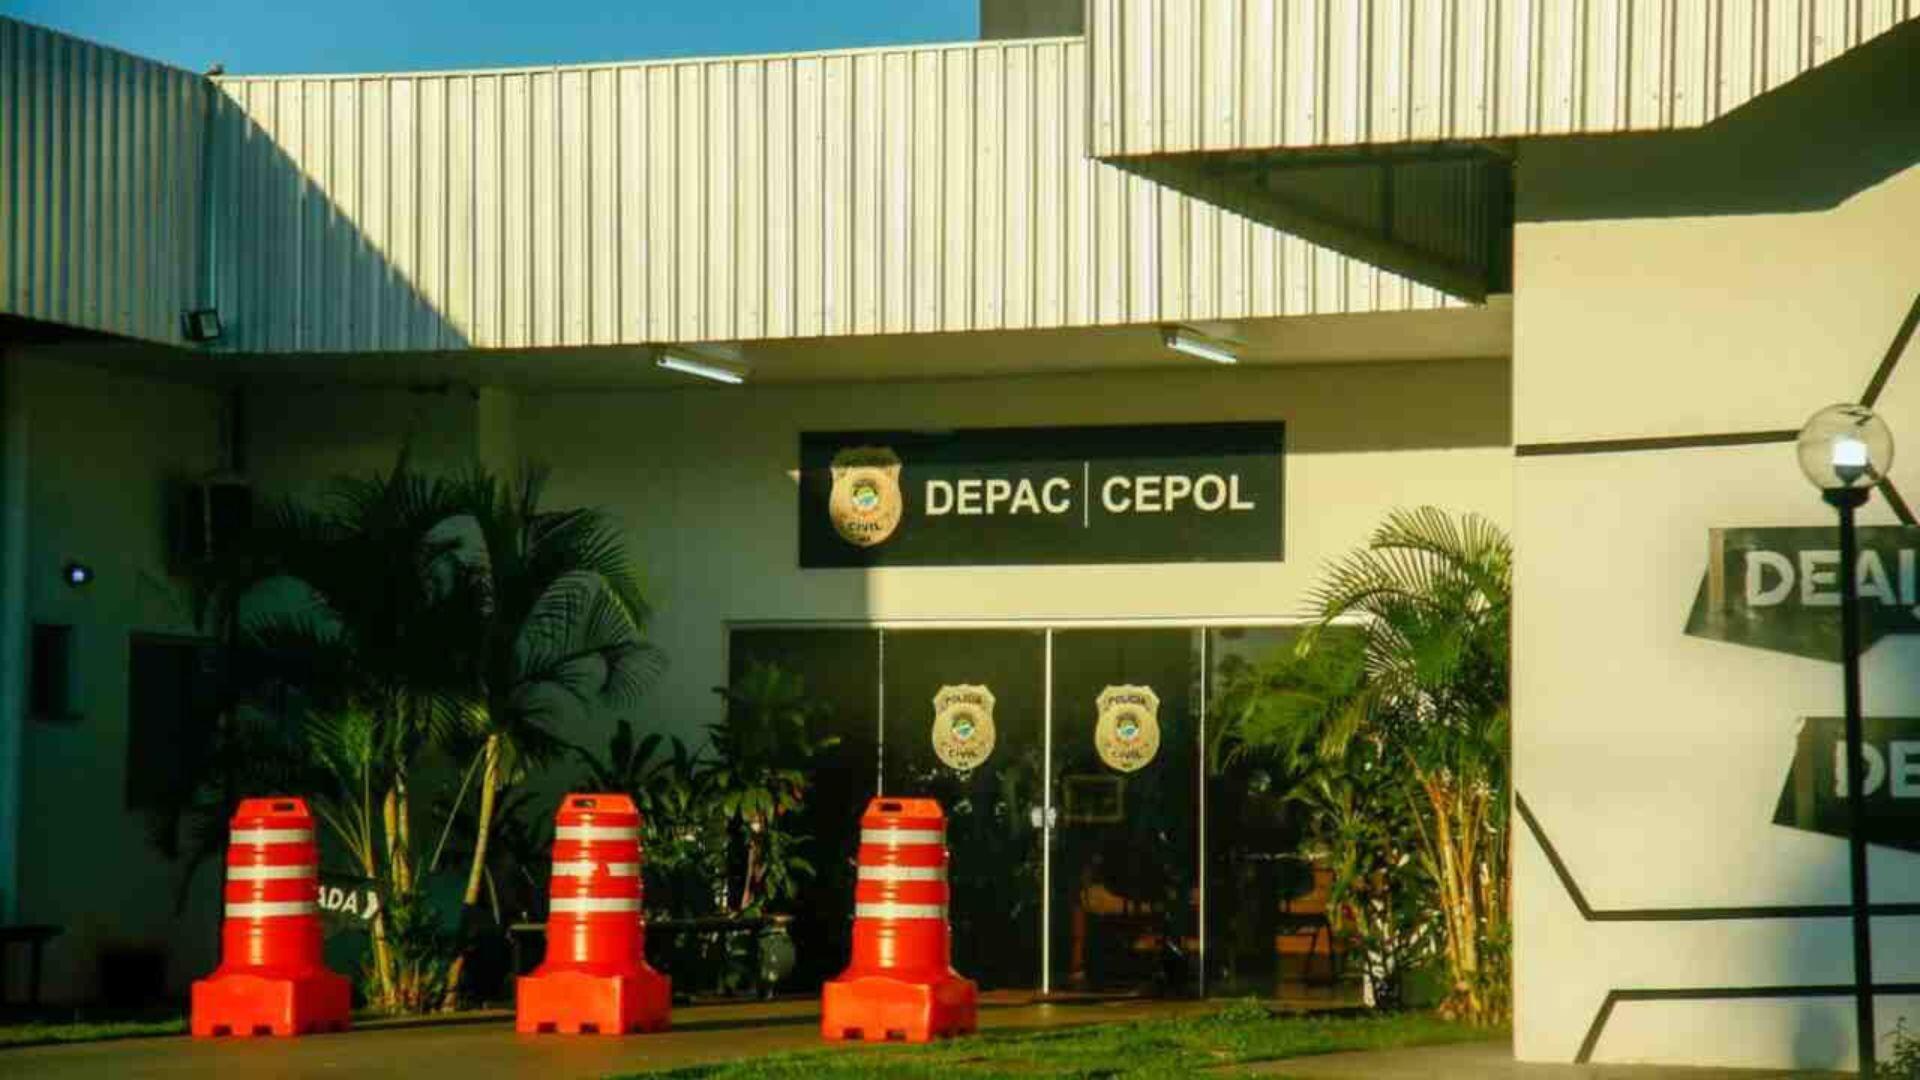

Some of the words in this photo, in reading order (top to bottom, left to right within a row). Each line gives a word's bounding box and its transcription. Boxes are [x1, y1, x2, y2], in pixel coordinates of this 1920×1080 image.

[924, 478, 1071, 515] DEPAC
[1102, 474, 1255, 512] CEPOL
[1745, 549, 1920, 618] DEAI
